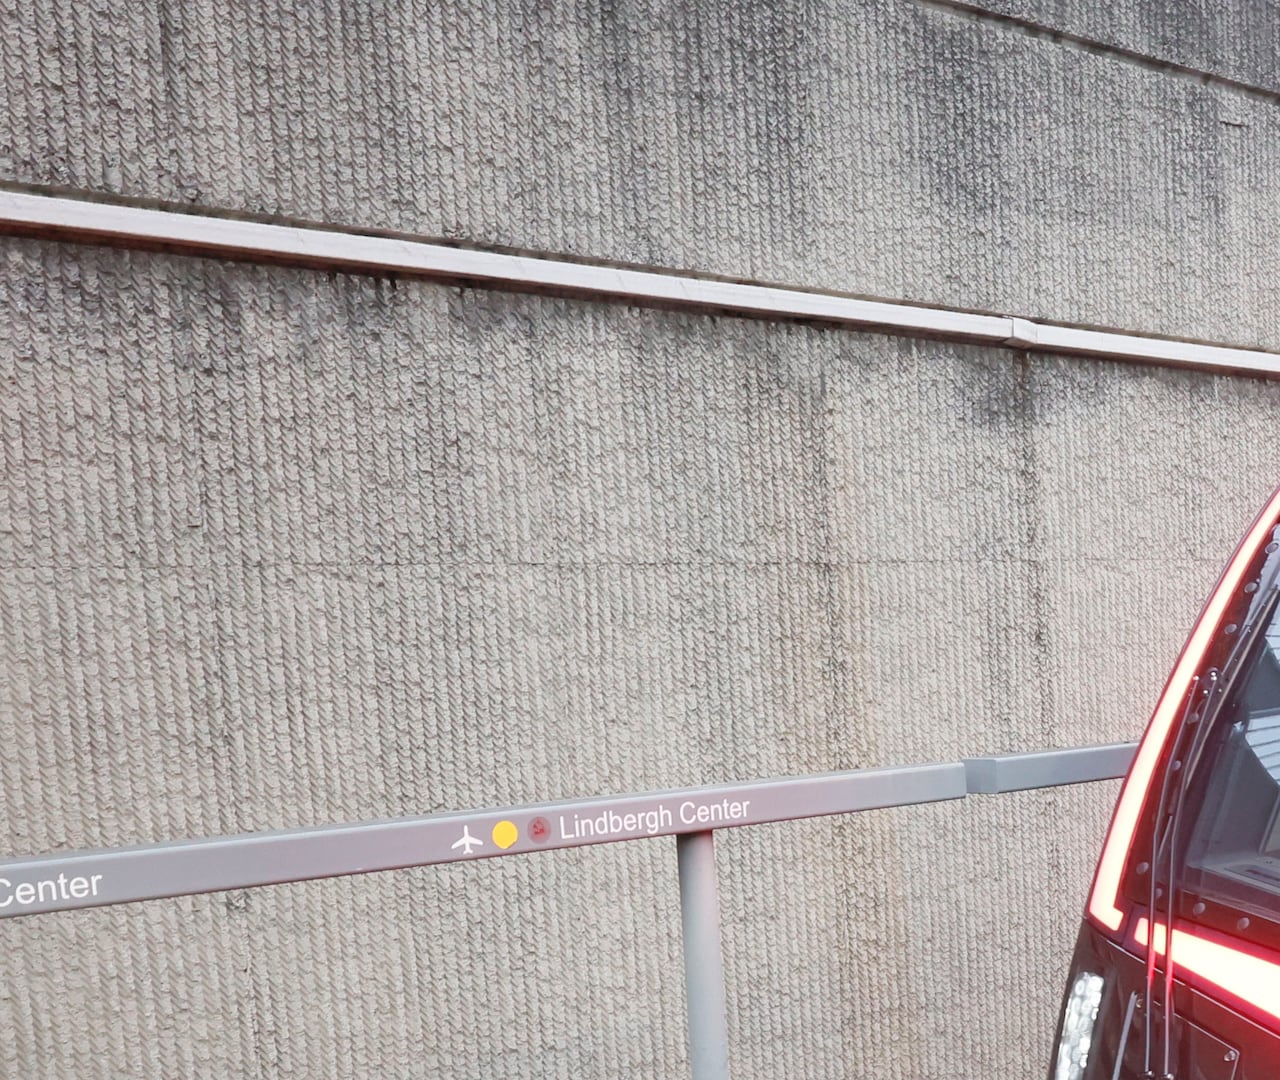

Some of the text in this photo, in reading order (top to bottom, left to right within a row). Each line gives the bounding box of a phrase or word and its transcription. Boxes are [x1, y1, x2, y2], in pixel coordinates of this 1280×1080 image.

[560, 800, 751, 841] Lindbergh Center
[0, 872, 103, 909] Center
